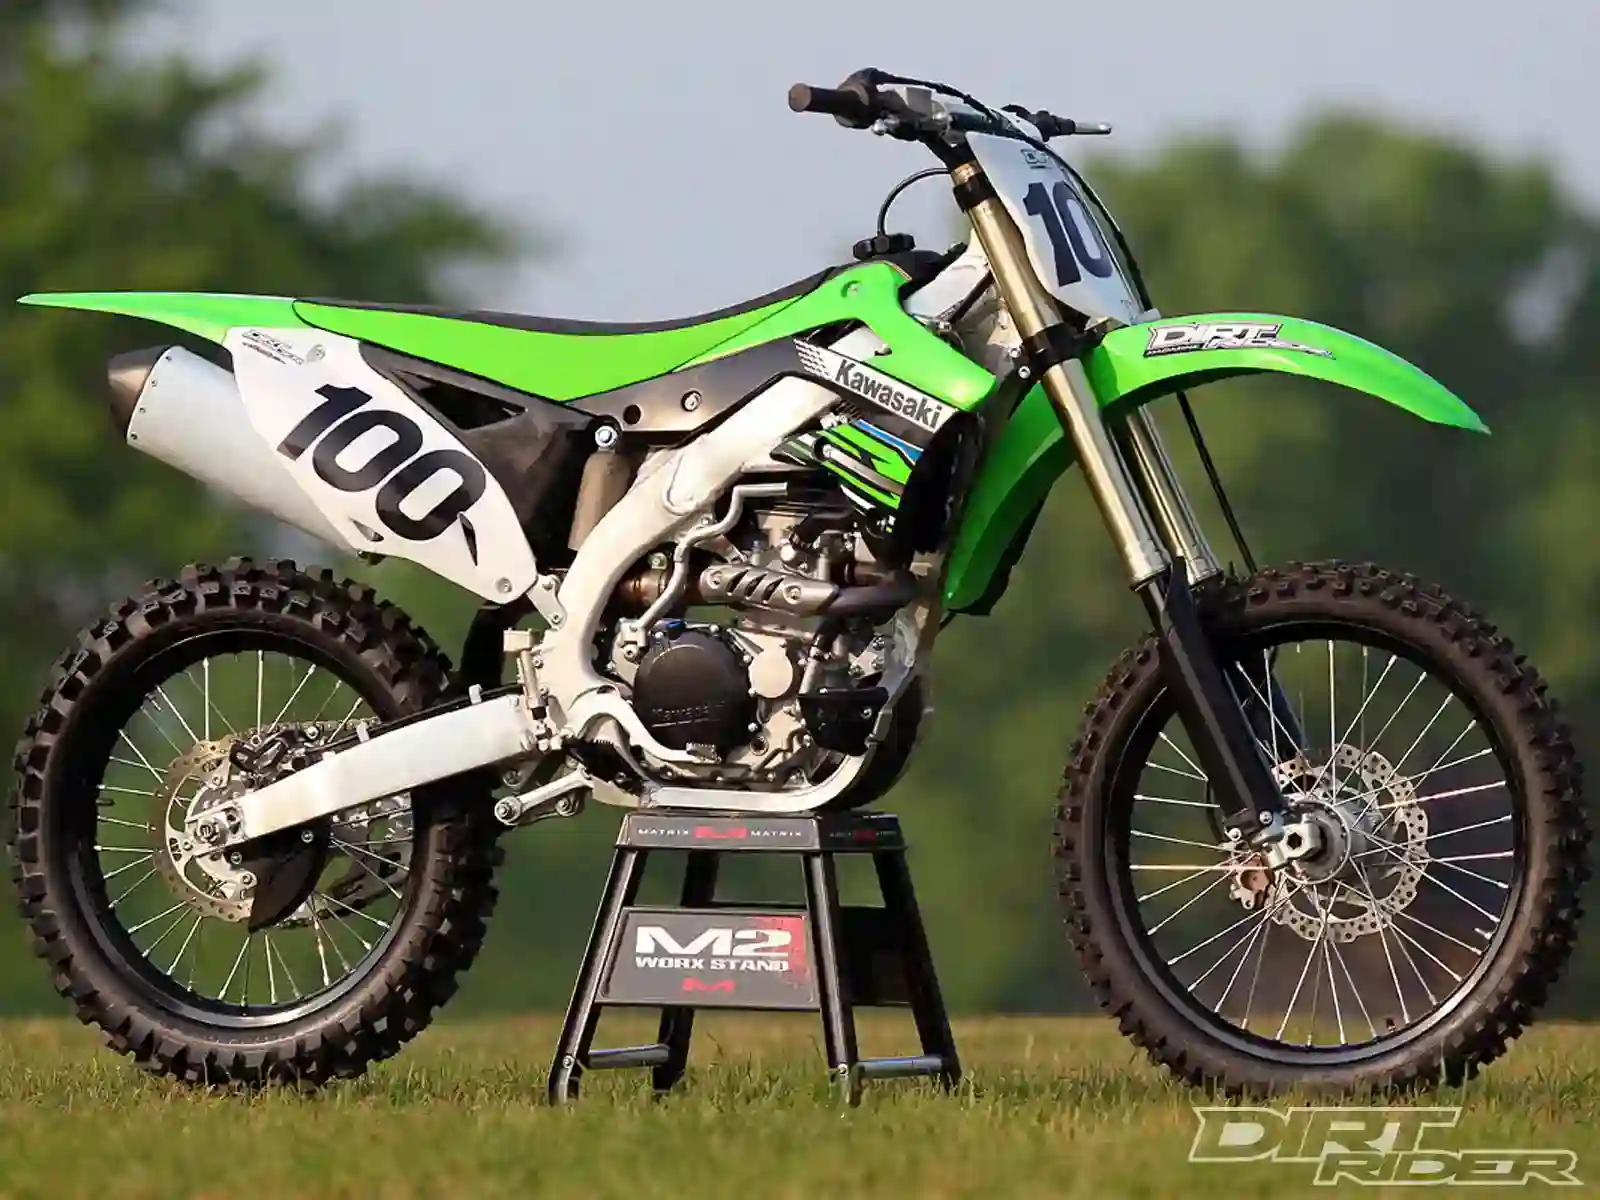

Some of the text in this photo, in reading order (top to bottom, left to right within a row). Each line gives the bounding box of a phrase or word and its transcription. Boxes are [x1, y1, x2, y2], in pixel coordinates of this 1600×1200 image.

[834, 358, 943, 429] Kawasaki
[276, 383, 486, 541] 100
[637, 827, 690, 836] MATRIX
[750, 829, 802, 837] MATRIX
[635, 926, 792, 956] M2
[710, 958, 789, 972] STAND
